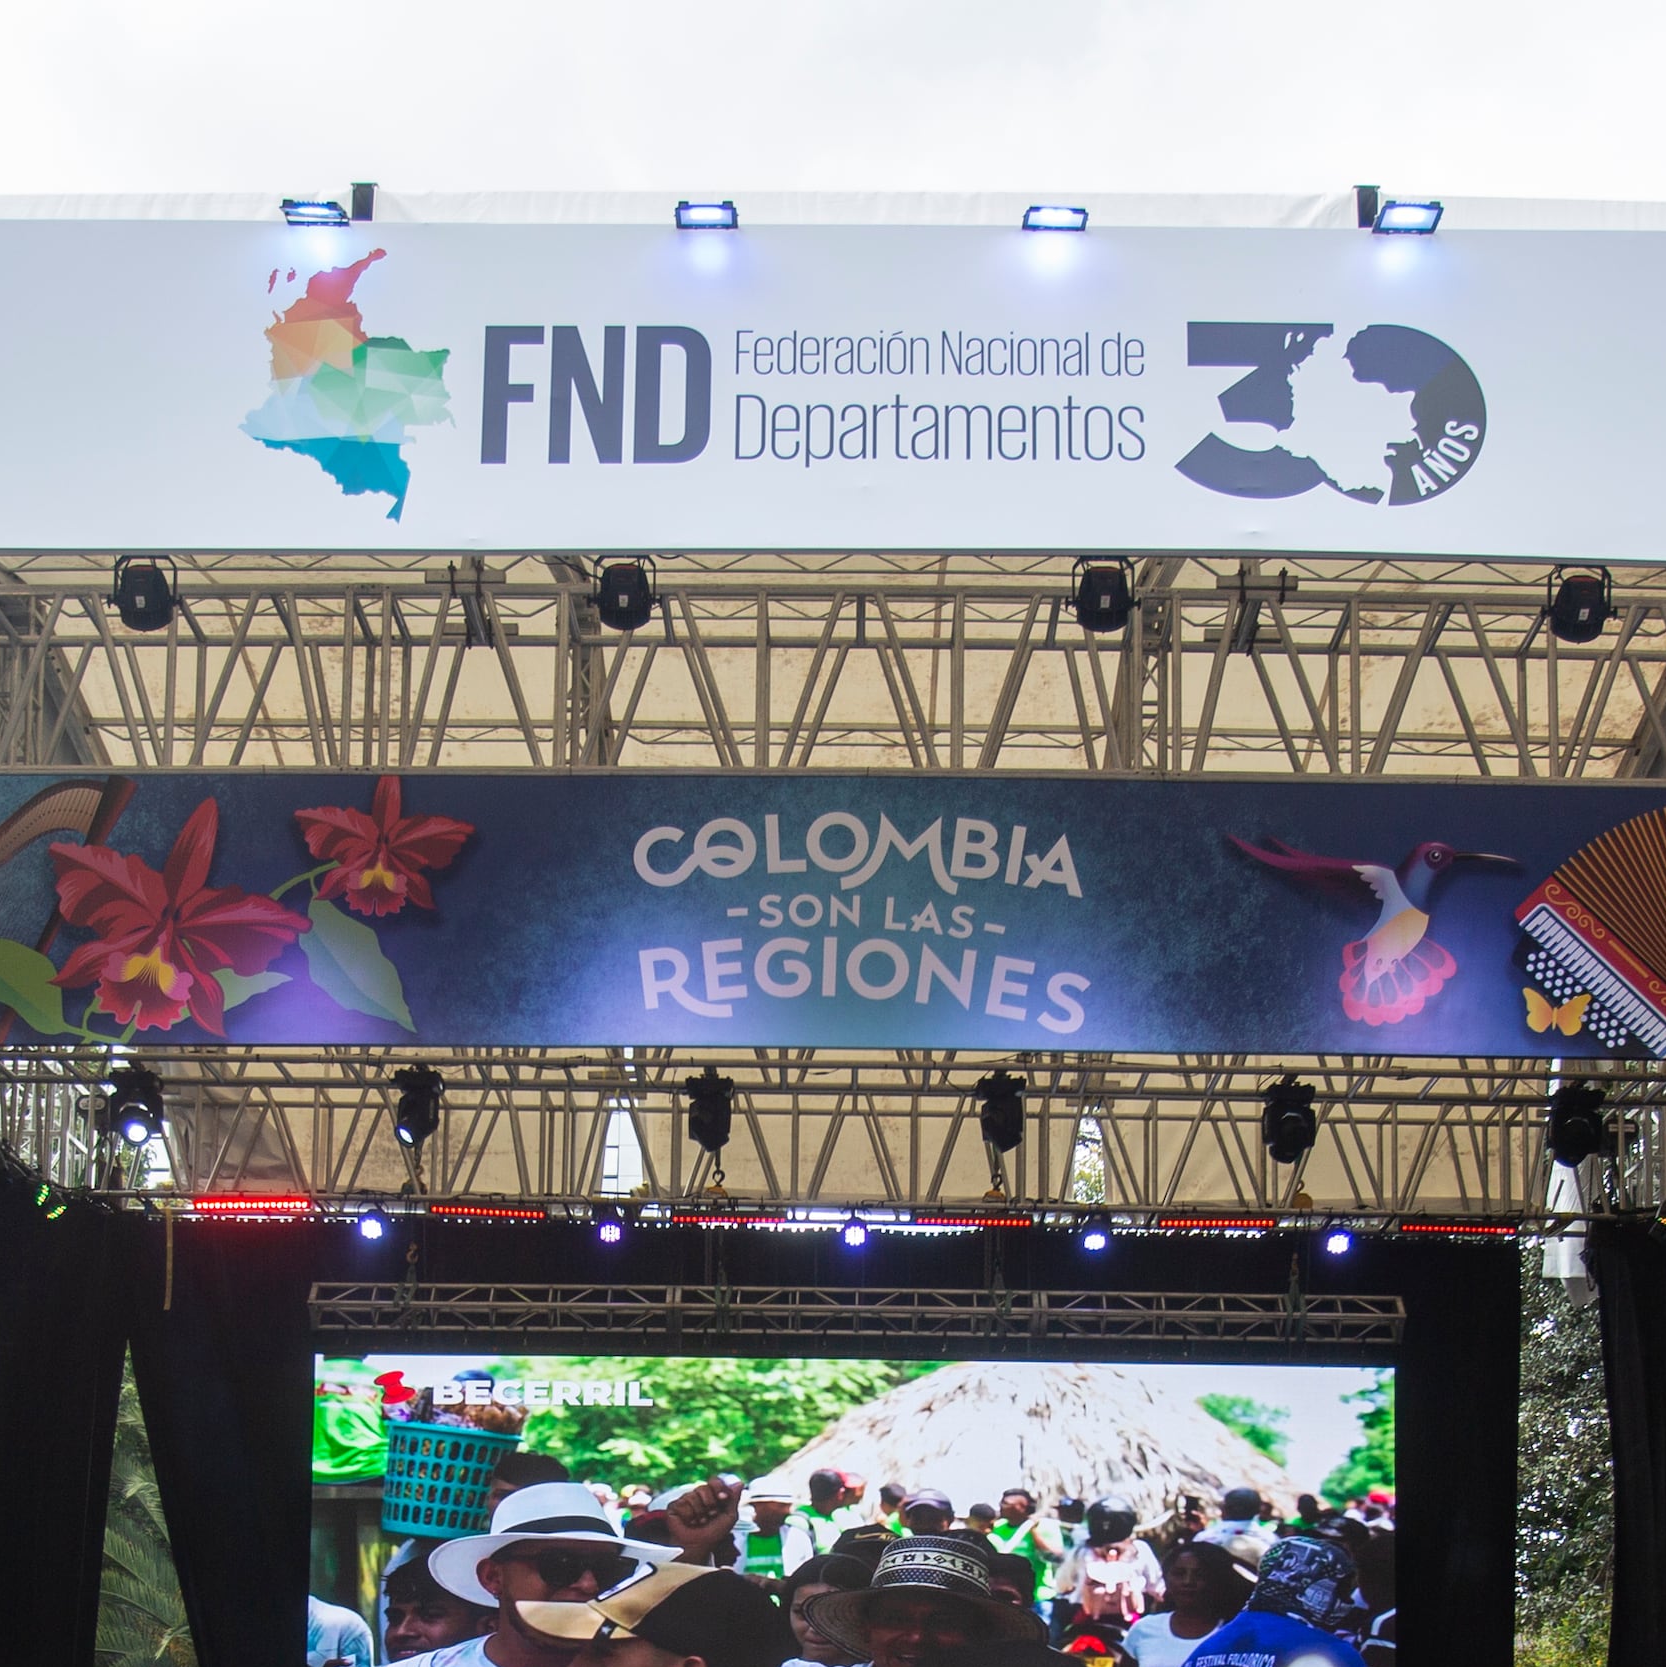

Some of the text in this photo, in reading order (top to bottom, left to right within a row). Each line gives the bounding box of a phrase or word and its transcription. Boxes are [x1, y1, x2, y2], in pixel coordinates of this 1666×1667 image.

[735, 330, 1145, 377] Federación Nacional de
[480, 325, 712, 464] FND
[734, 394, 1146, 468] Departamentos
[1411, 420, 1479, 497] AÑOS
[633, 811, 1083, 898] COLOMBIA
[638, 936, 1091, 1034] REGIONES
[433, 1379, 654, 1407] BECERRIL
